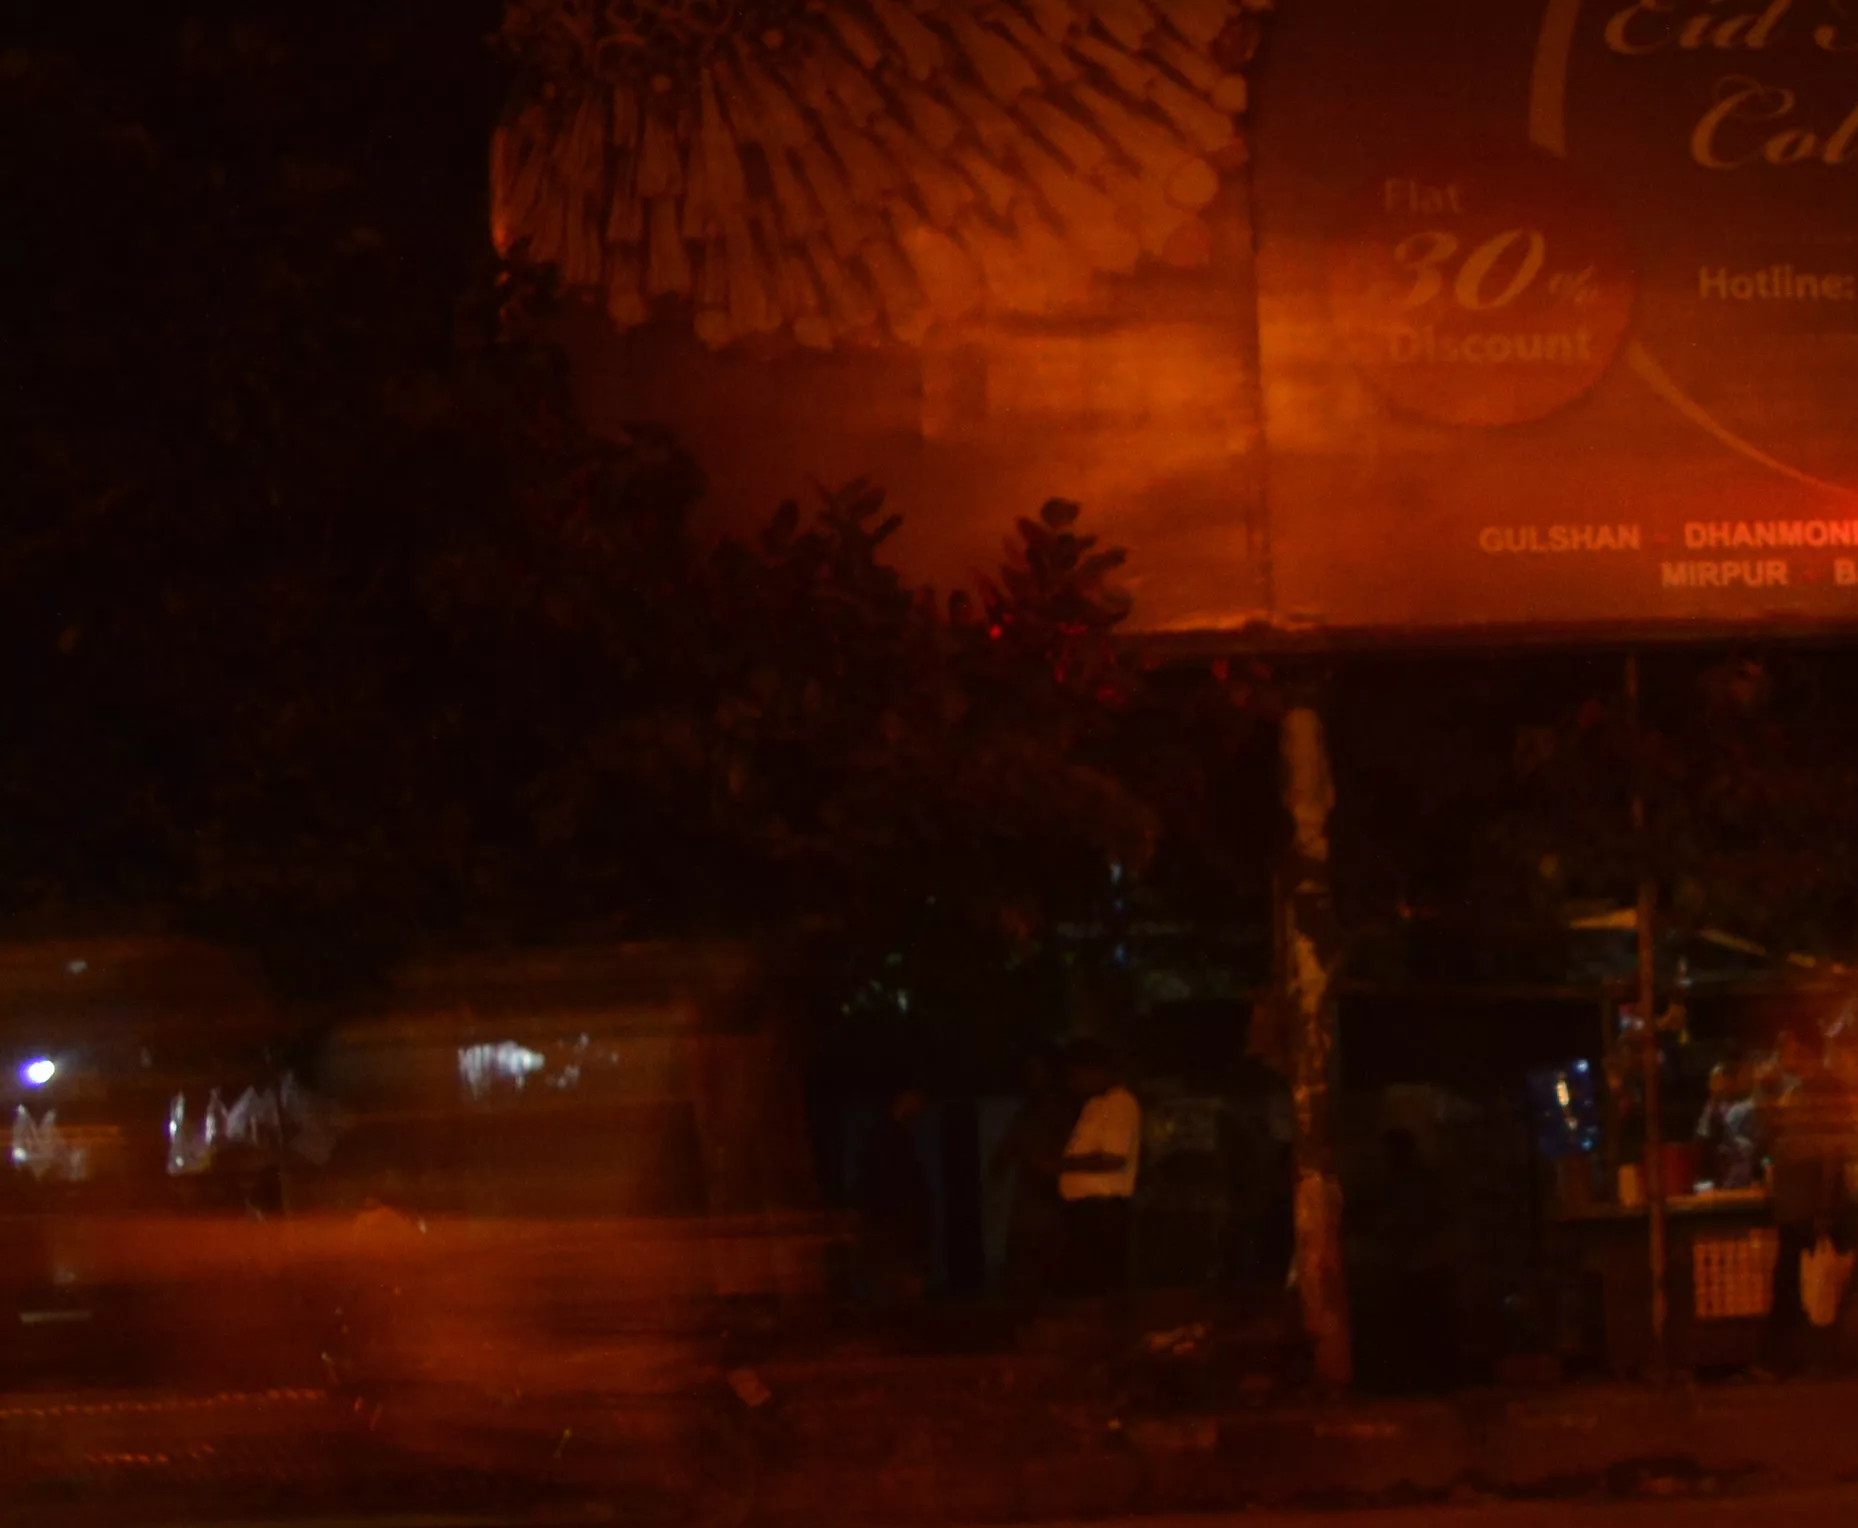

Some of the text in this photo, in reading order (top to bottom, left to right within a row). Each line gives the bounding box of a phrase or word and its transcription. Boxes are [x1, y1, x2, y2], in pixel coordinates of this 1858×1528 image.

[1384, 178, 1464, 216] Flat
[1700, 265, 1855, 300] Hotline:
[1390, 323, 1592, 363] Discount
[1477, 522, 1643, 553] GULSHAN
[1659, 559, 1790, 588] MIRPUR
